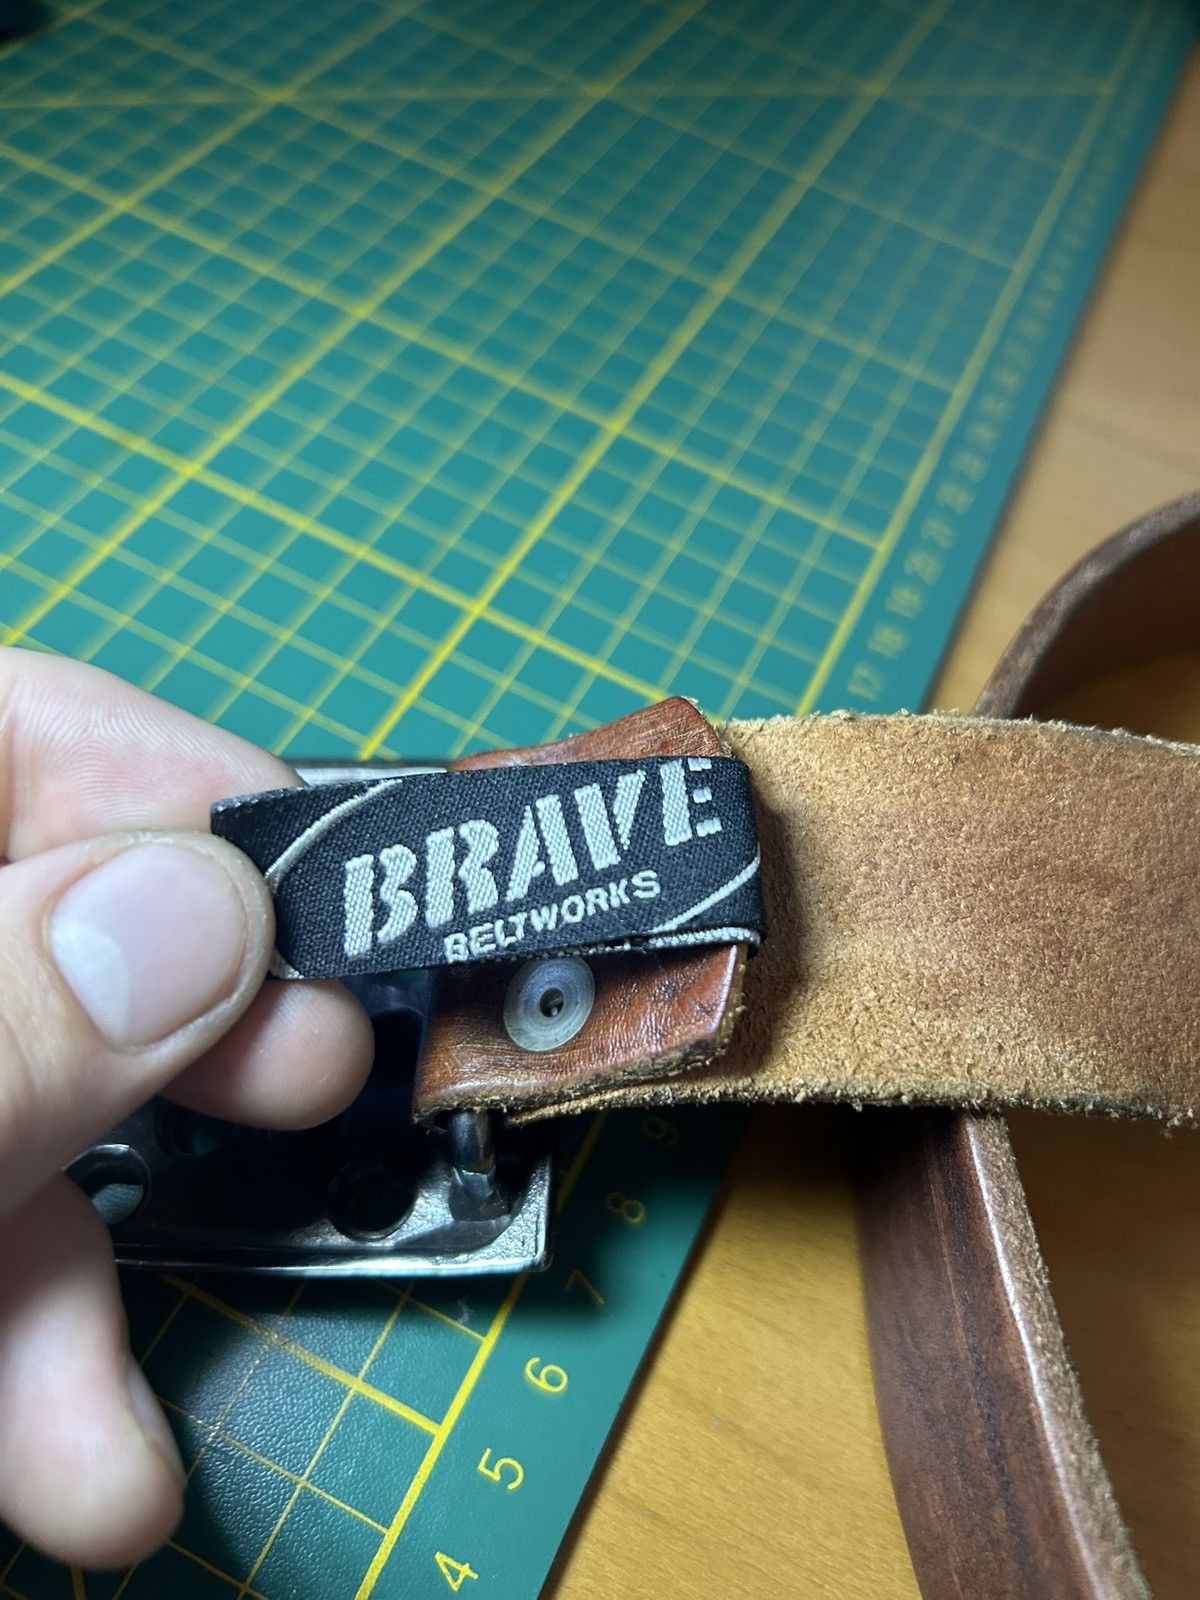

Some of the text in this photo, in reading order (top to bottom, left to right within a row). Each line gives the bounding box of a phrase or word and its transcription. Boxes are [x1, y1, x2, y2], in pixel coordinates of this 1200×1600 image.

[847, 662, 884, 701] 17
[344, 757, 723, 958] BRAVE
[443, 869, 662, 964] BELTWORKS
[604, 1190, 646, 1225] 8
[564, 1269, 605, 1305] 7
[524, 1357, 568, 1393] 6
[477, 1447, 525, 1491] 5
[434, 1551, 479, 1592] 4
